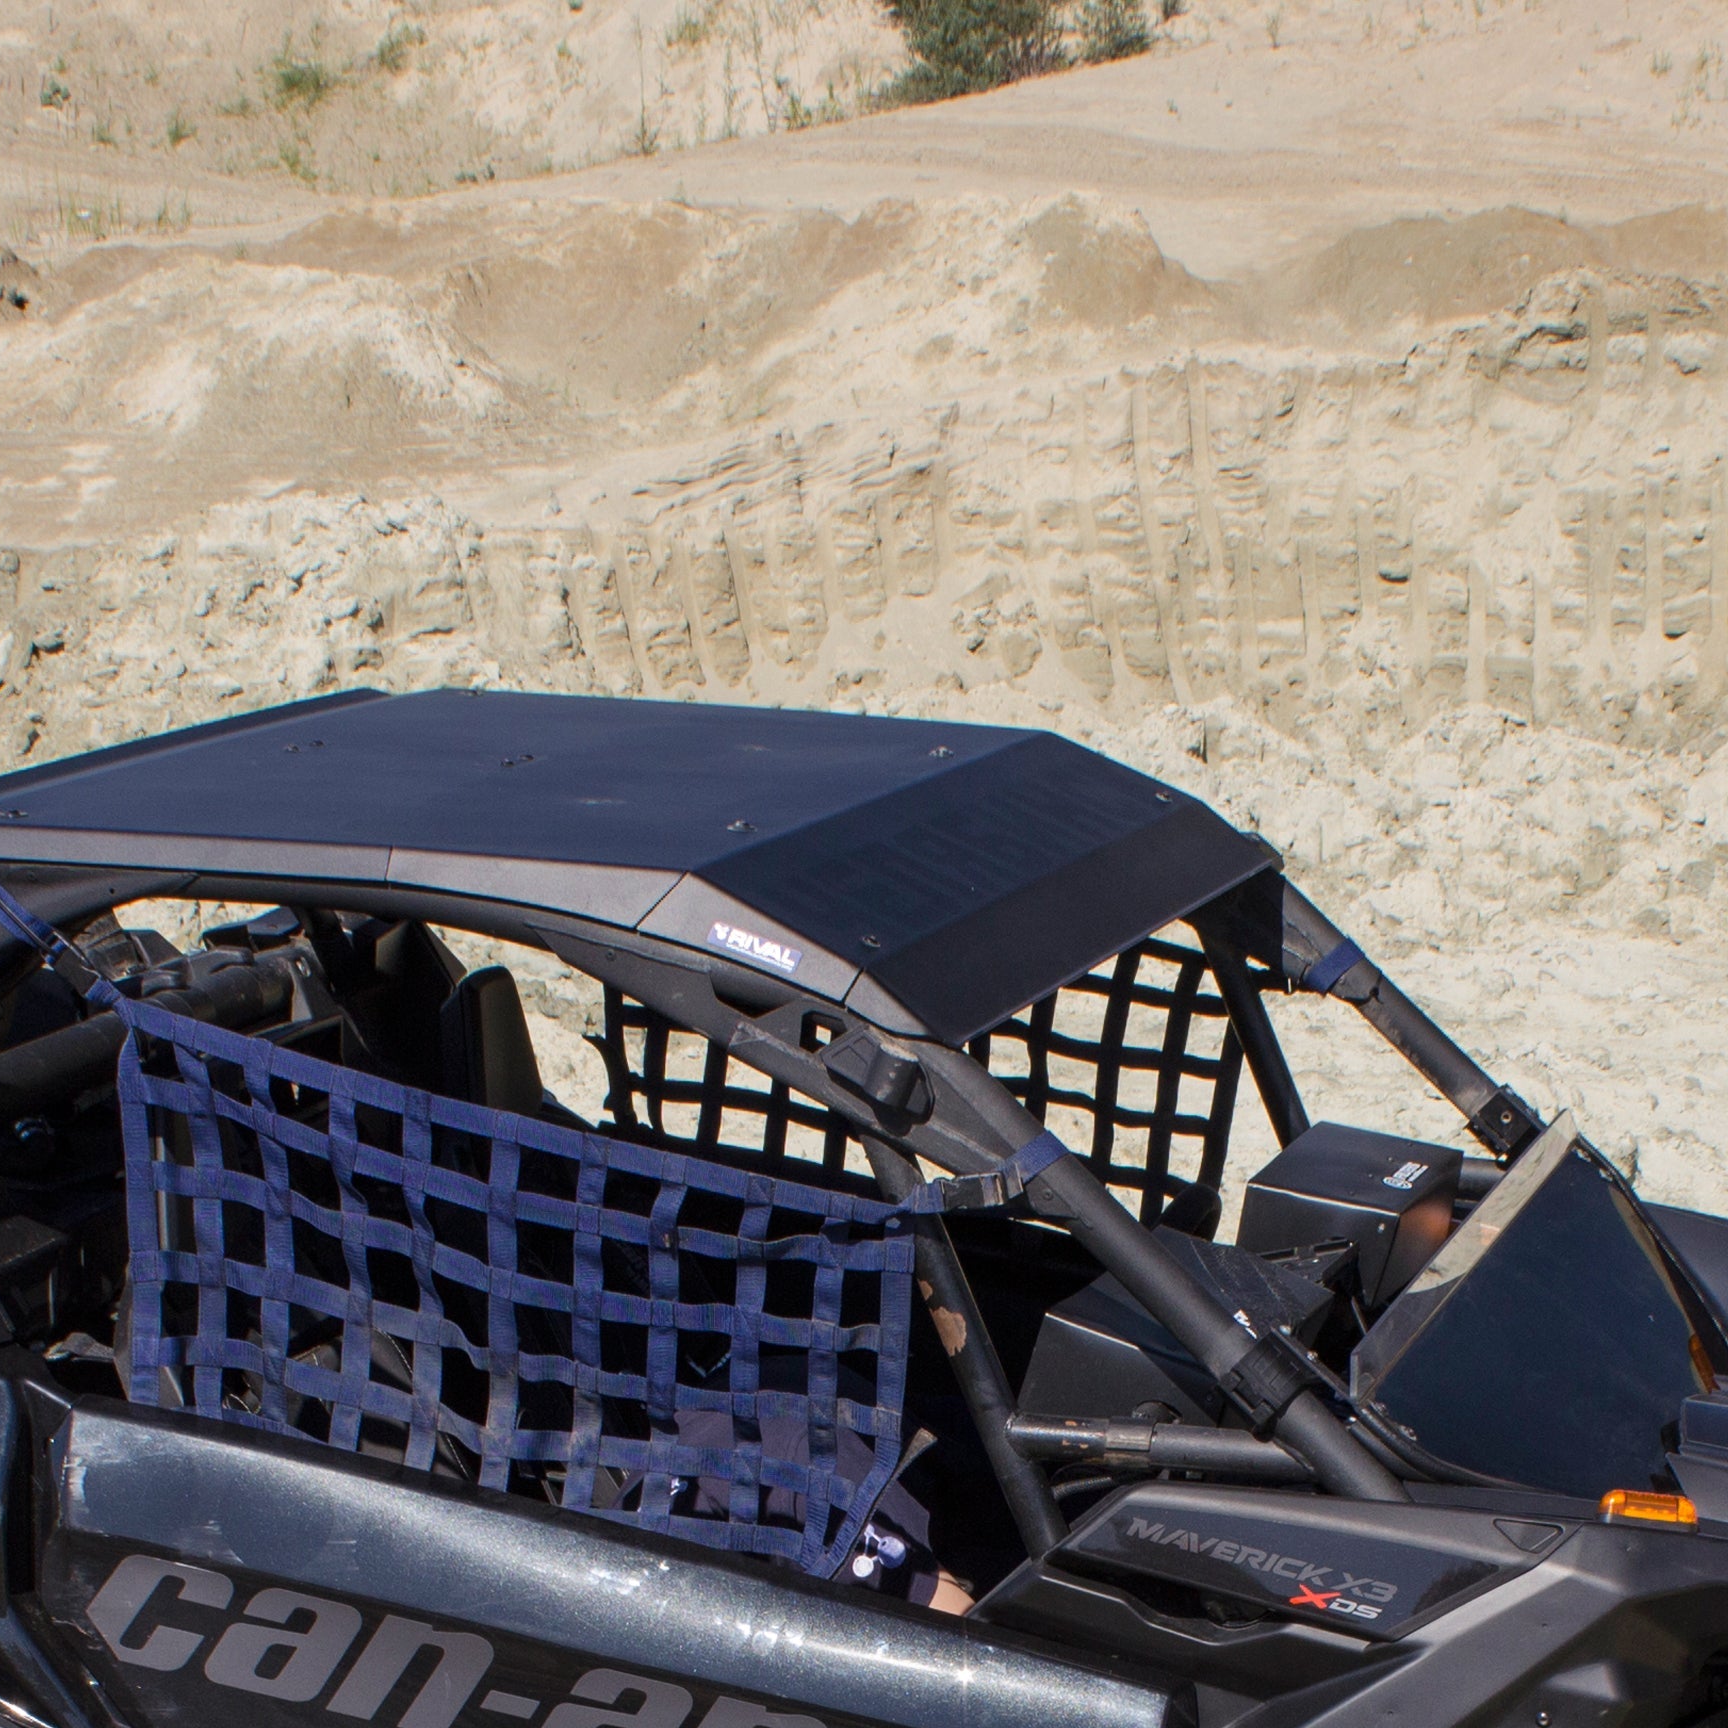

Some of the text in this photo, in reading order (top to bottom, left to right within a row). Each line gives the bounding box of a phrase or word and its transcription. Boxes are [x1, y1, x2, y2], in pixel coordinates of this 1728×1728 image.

[726, 928, 796, 967] RIVAL
[1126, 1517, 1398, 1603] MAVERICK X3
